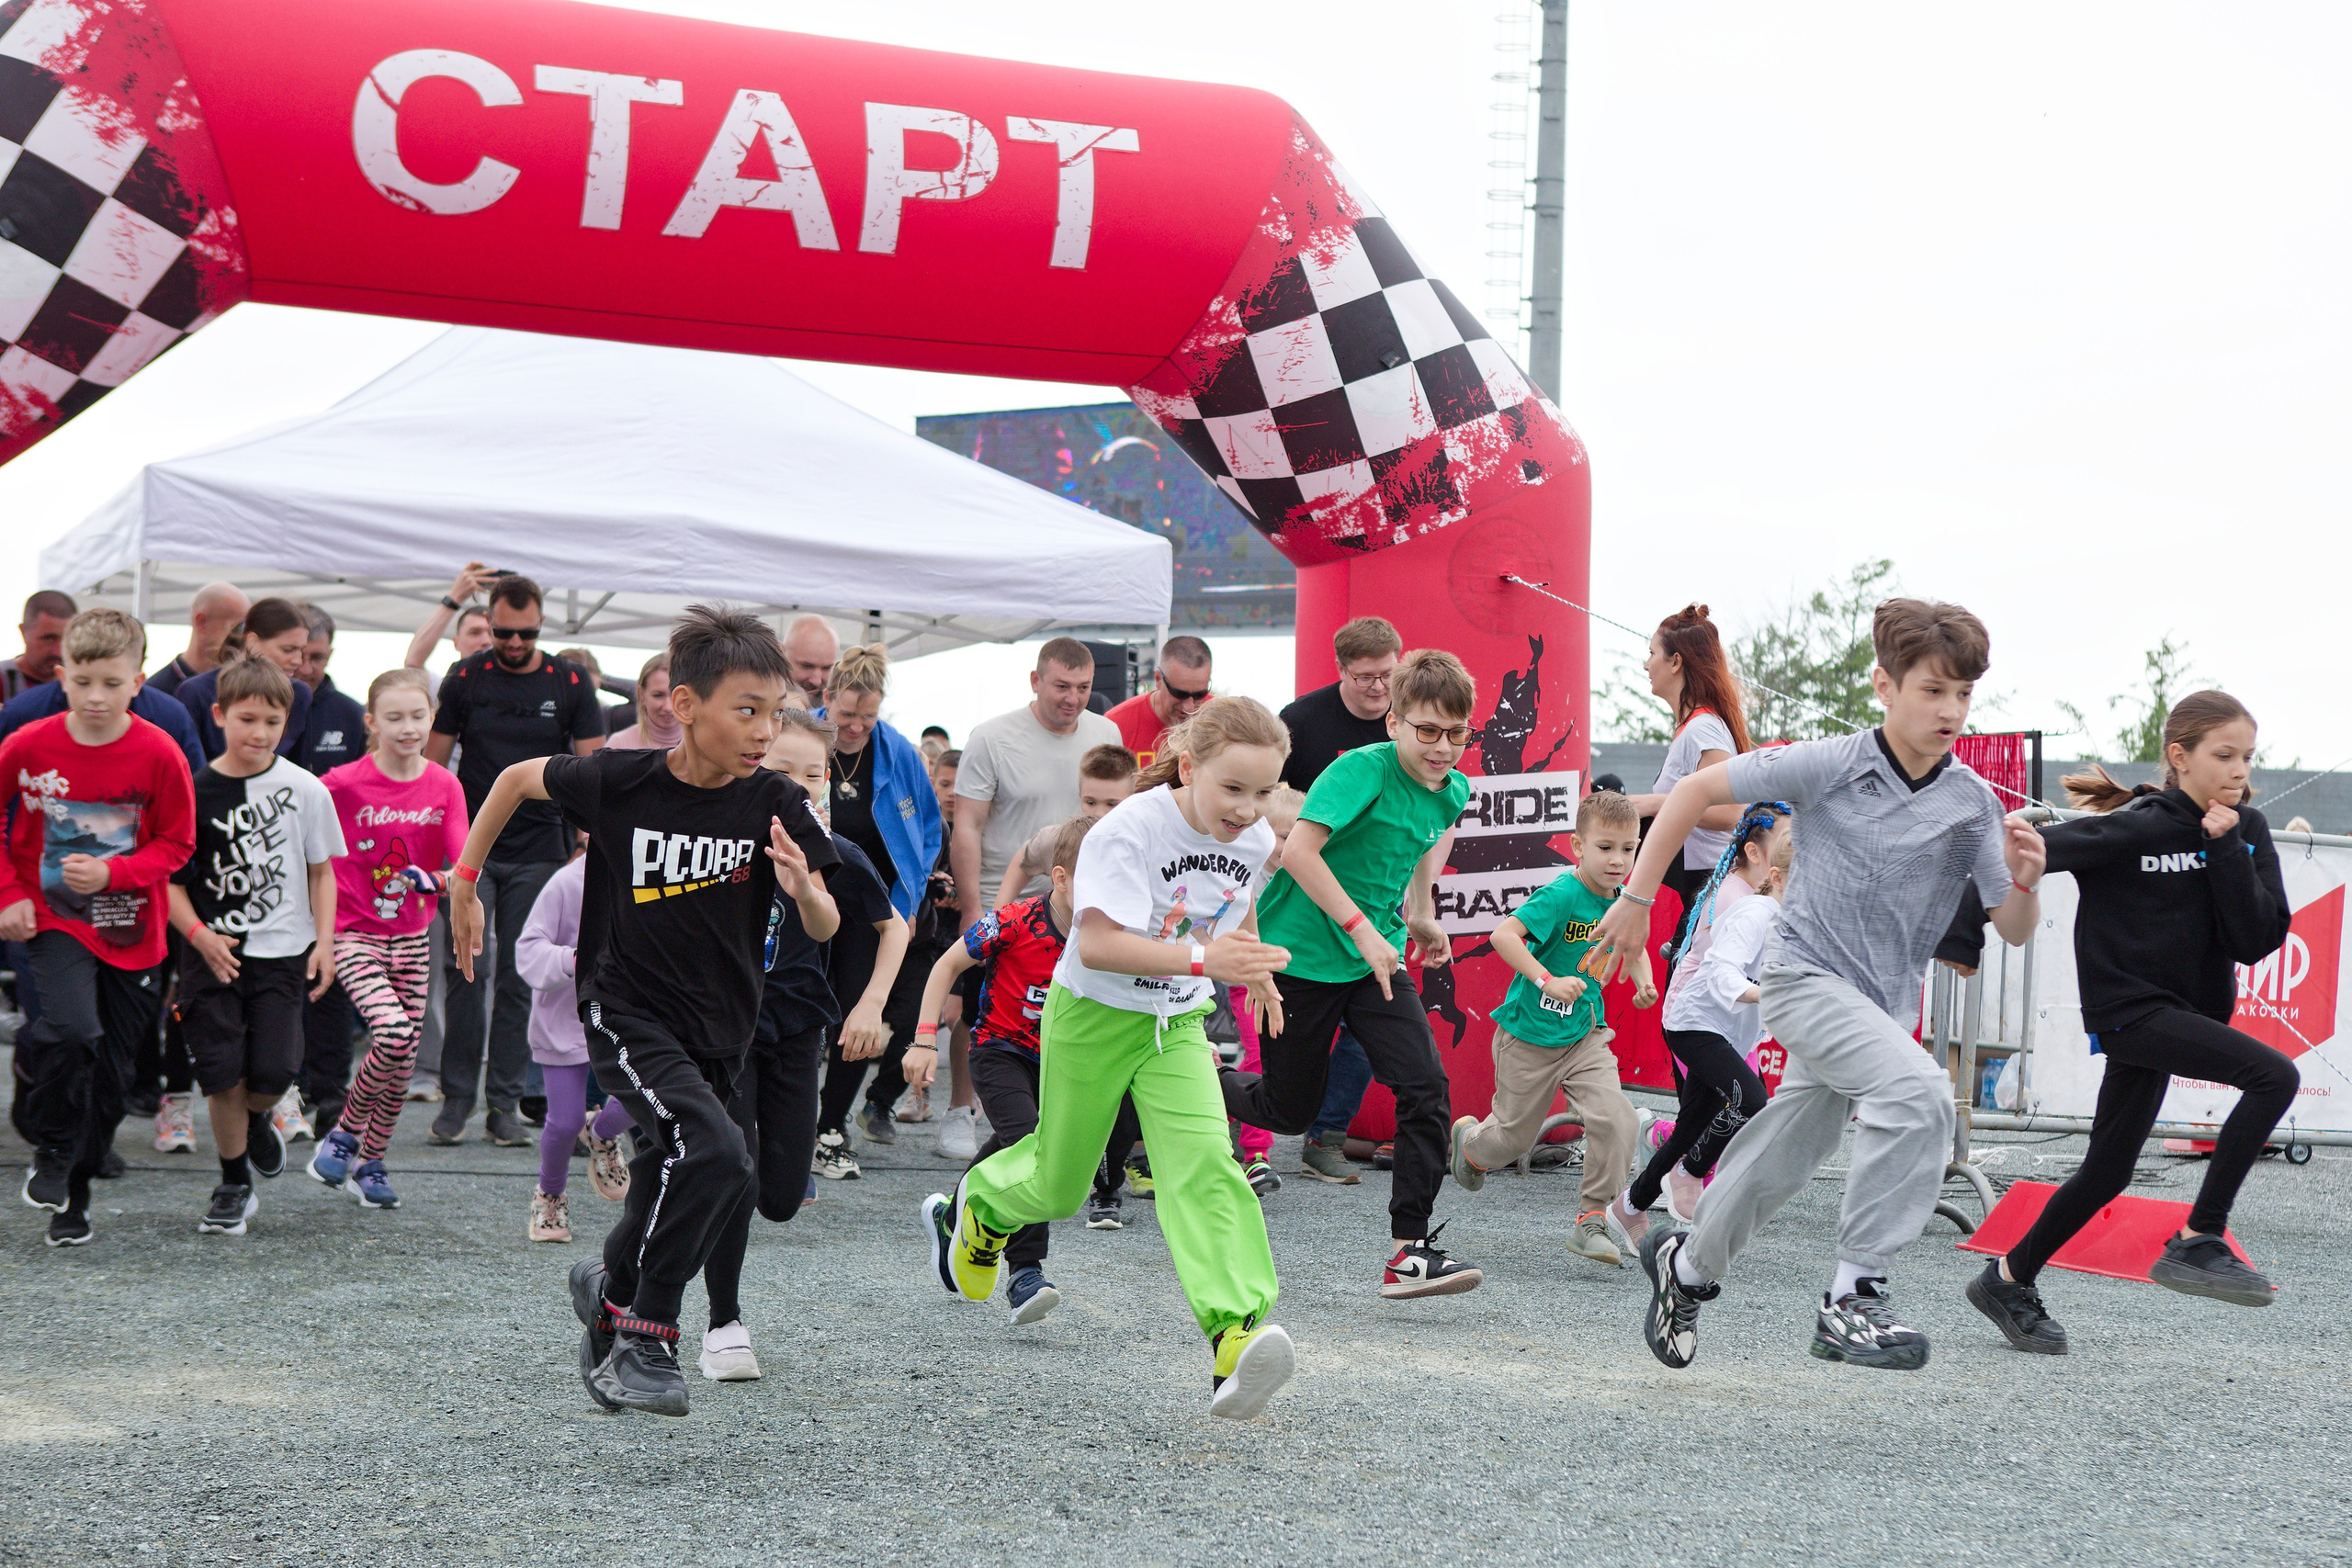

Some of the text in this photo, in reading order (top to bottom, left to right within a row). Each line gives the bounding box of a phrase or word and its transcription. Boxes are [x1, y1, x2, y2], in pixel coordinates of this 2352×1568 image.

[352, 48, 1140, 273] СТАРТ
[211, 786, 299, 840] YOUR
[1454, 786, 1569, 829] RIDE
[212, 819, 288, 875] LIFE
[205, 854, 288, 901] YOUR
[731, 865, 751, 884] 68
[1161, 853, 1251, 888] WANDERFUL
[1434, 885, 1547, 920] RAC
[1544, 998, 1570, 1013] PLAY
[2236, 1005, 2300, 1020] АКОВКИ
[591, 1000, 620, 1045] NTERNATIONAL
[661, 1167, 671, 1186] AND
[2172, 1077, 2207, 1089] Чтобы
